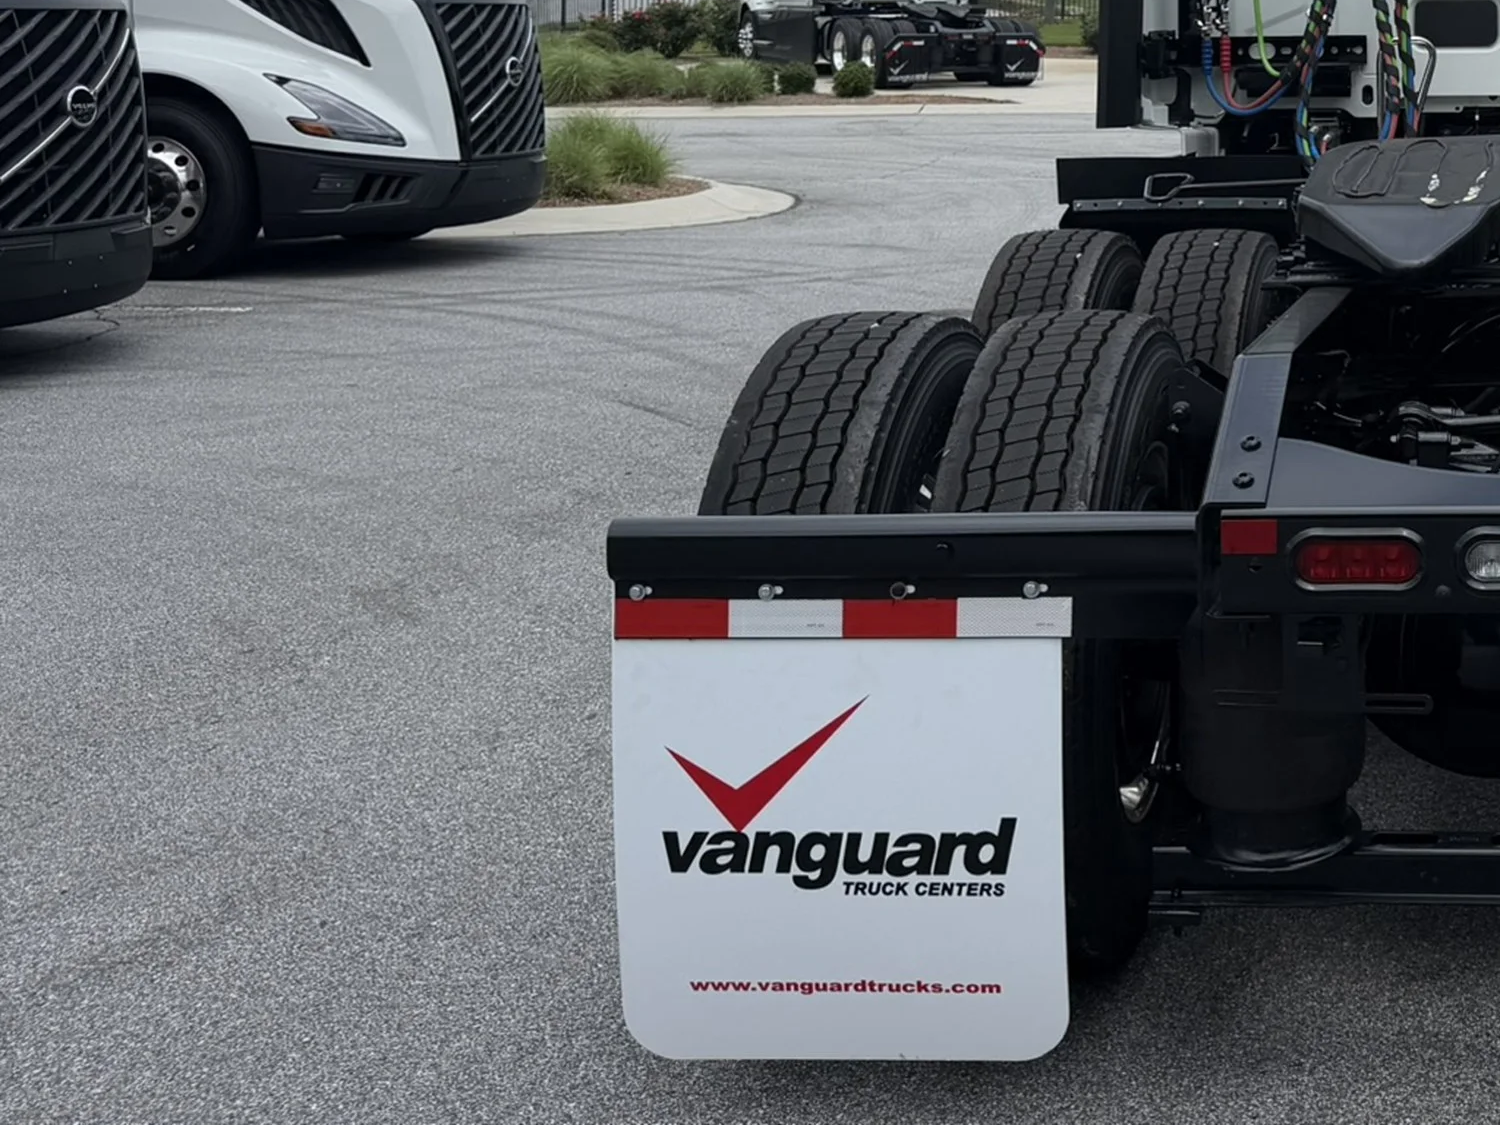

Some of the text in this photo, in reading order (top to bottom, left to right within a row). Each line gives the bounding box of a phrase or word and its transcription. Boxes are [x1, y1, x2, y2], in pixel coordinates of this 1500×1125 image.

[662, 817, 1018, 890] vanguard
[842, 881, 1006, 897] TRUCK CENTERS
[690, 979, 1002, 995] www.vanguardtrucks.com
